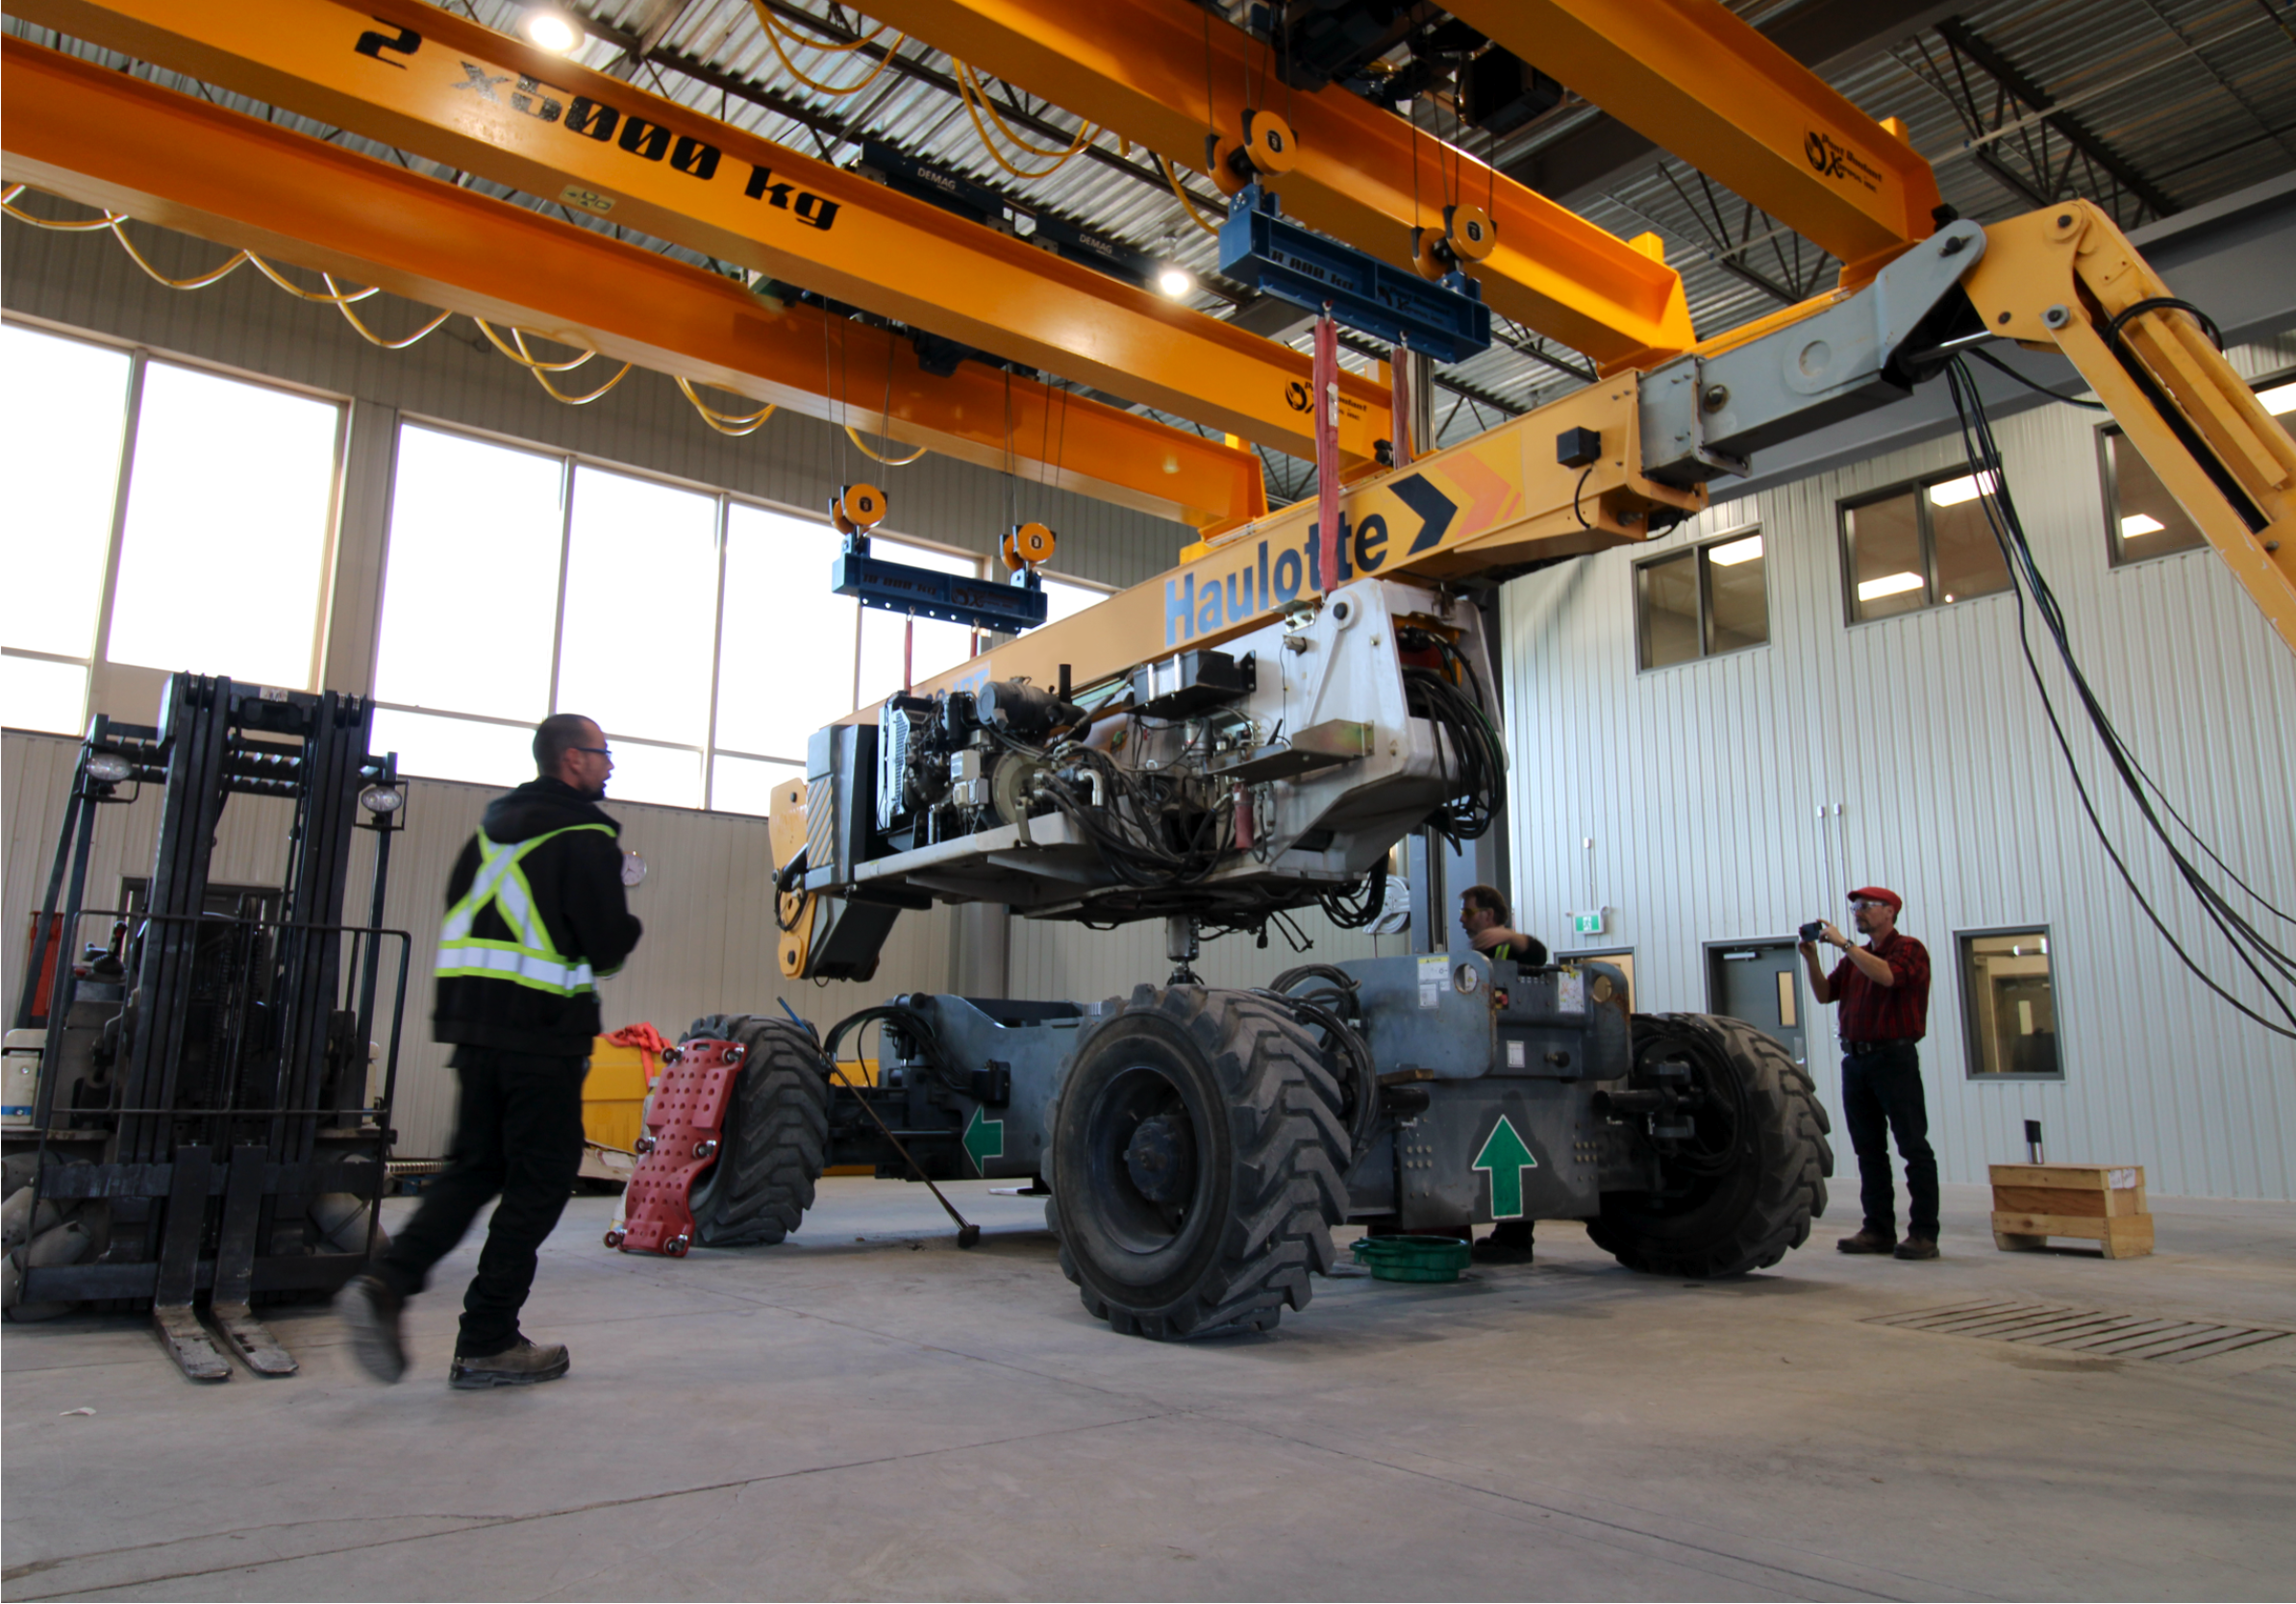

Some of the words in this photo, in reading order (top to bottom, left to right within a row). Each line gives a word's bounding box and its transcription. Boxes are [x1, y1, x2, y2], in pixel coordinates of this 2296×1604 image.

[354, 15, 423, 70] 2
[743, 163, 842, 232] kg
[916, 165, 957, 190] DEMAG
[1078, 233, 1113, 255] DEMAG
[1164, 510, 1389, 647] Haulotte
